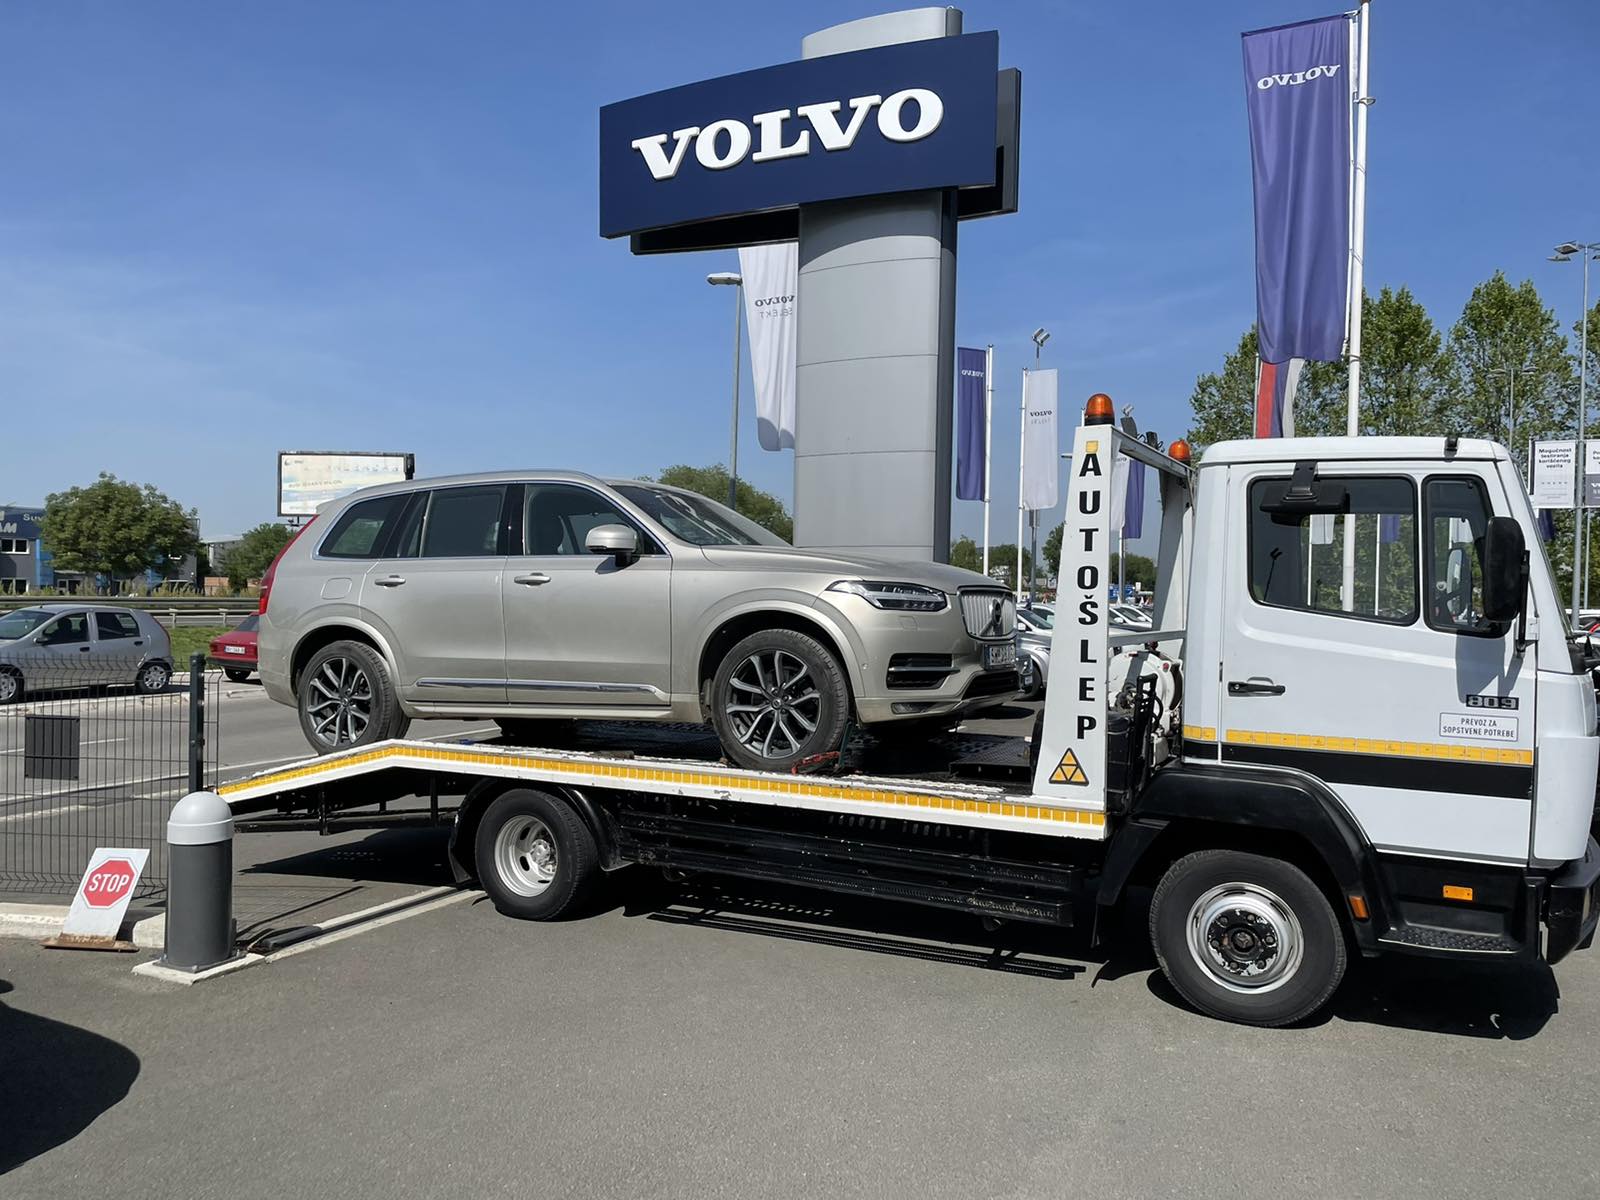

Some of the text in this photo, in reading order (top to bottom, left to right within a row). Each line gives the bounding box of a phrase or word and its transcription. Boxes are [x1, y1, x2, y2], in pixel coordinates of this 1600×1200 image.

[631, 88, 945, 181] VOLVO
[1076, 453, 1102, 740] AUTOŠLEP
[1467, 695, 1516, 709] 809
[1461, 717, 1497, 727] PREVOZ ZA
[1443, 726, 1514, 738] SOPSTVENE POTREBE
[88, 873, 130, 893] STOP
